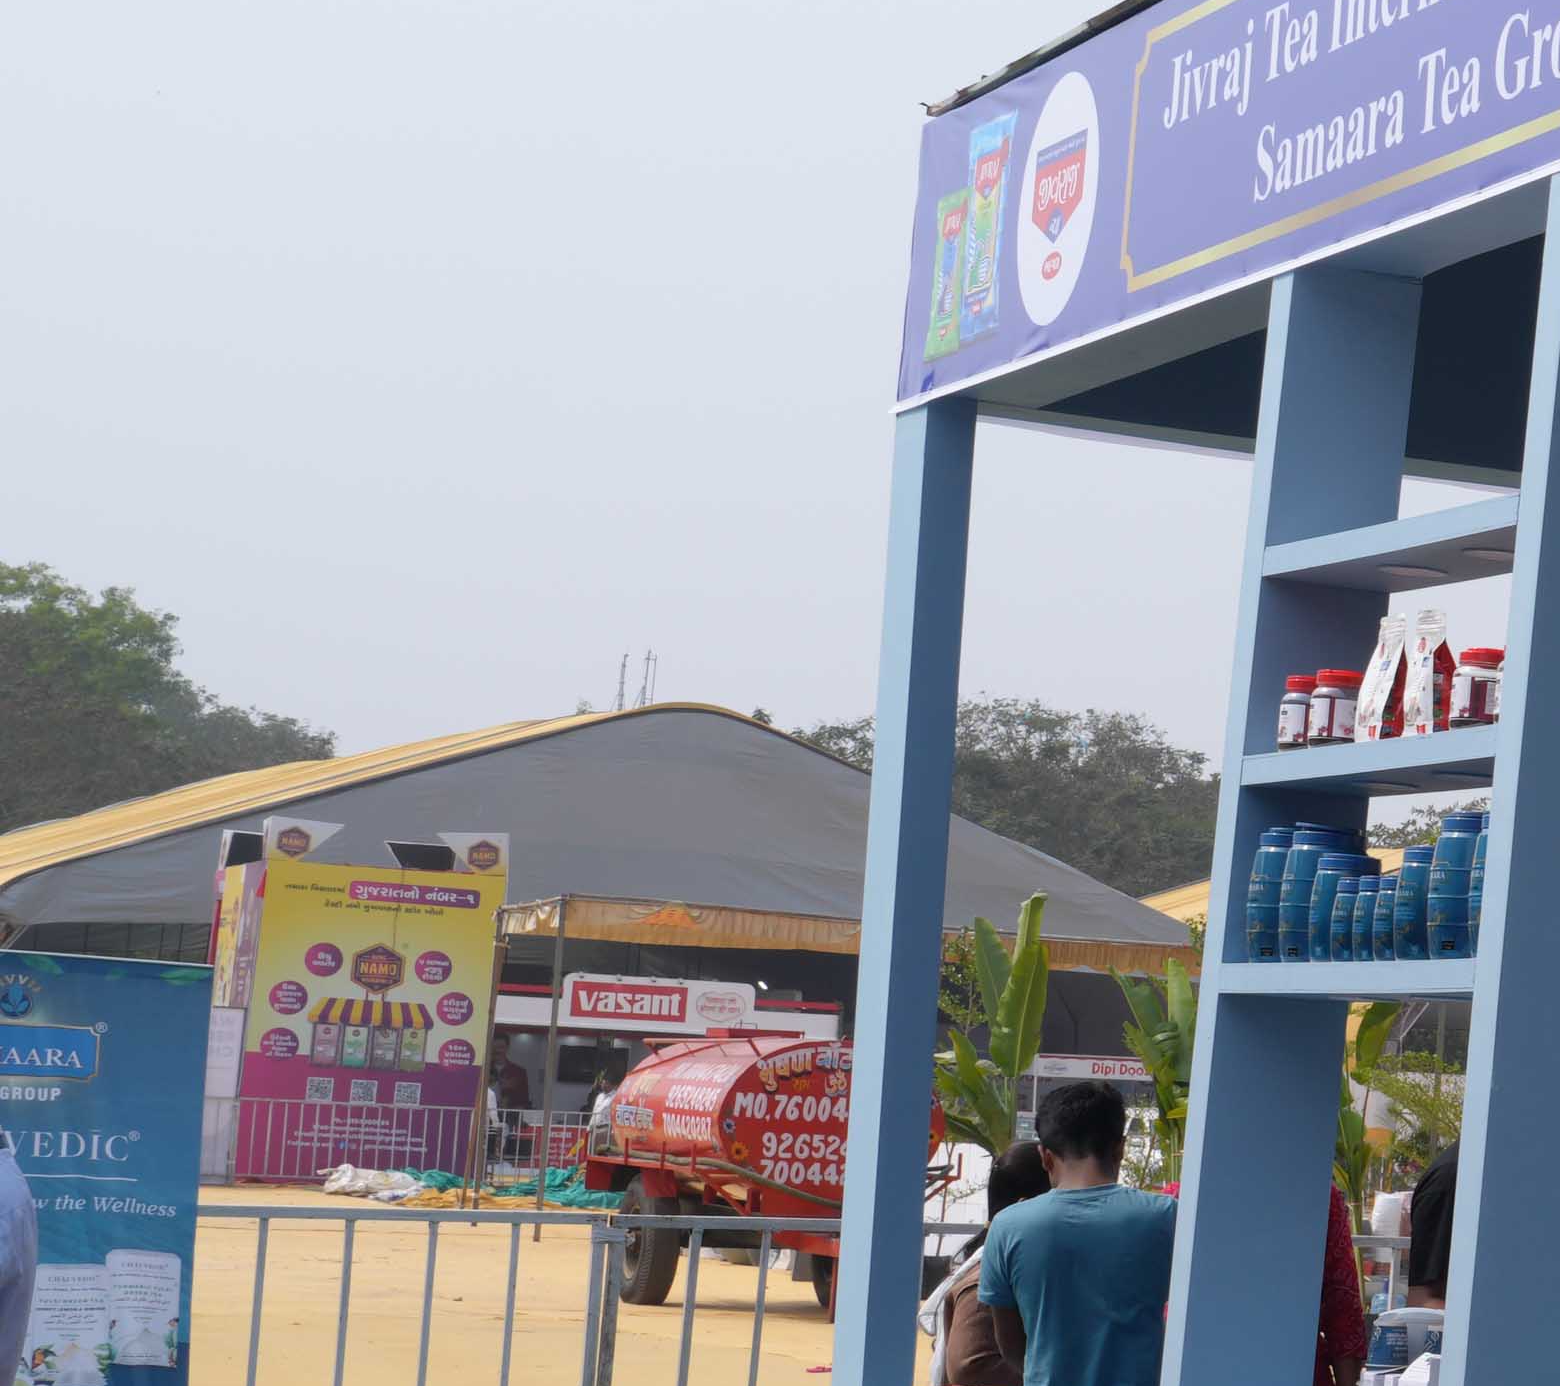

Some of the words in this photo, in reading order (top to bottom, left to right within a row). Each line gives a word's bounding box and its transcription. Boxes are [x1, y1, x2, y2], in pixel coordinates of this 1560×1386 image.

[1164, 19, 1253, 129] Jivraj
[1264, 2, 1319, 83] Tea
[1253, 85, 1403, 203] Samaara
[1417, 48, 1481, 135] Tea
[359, 961, 397, 975] NAMO
[0, 1046, 84, 1069] AARA
[0, 1086, 62, 1102] GROUP
[55, 1195, 87, 1211] the
[93, 1196, 177, 1218] Wellness
